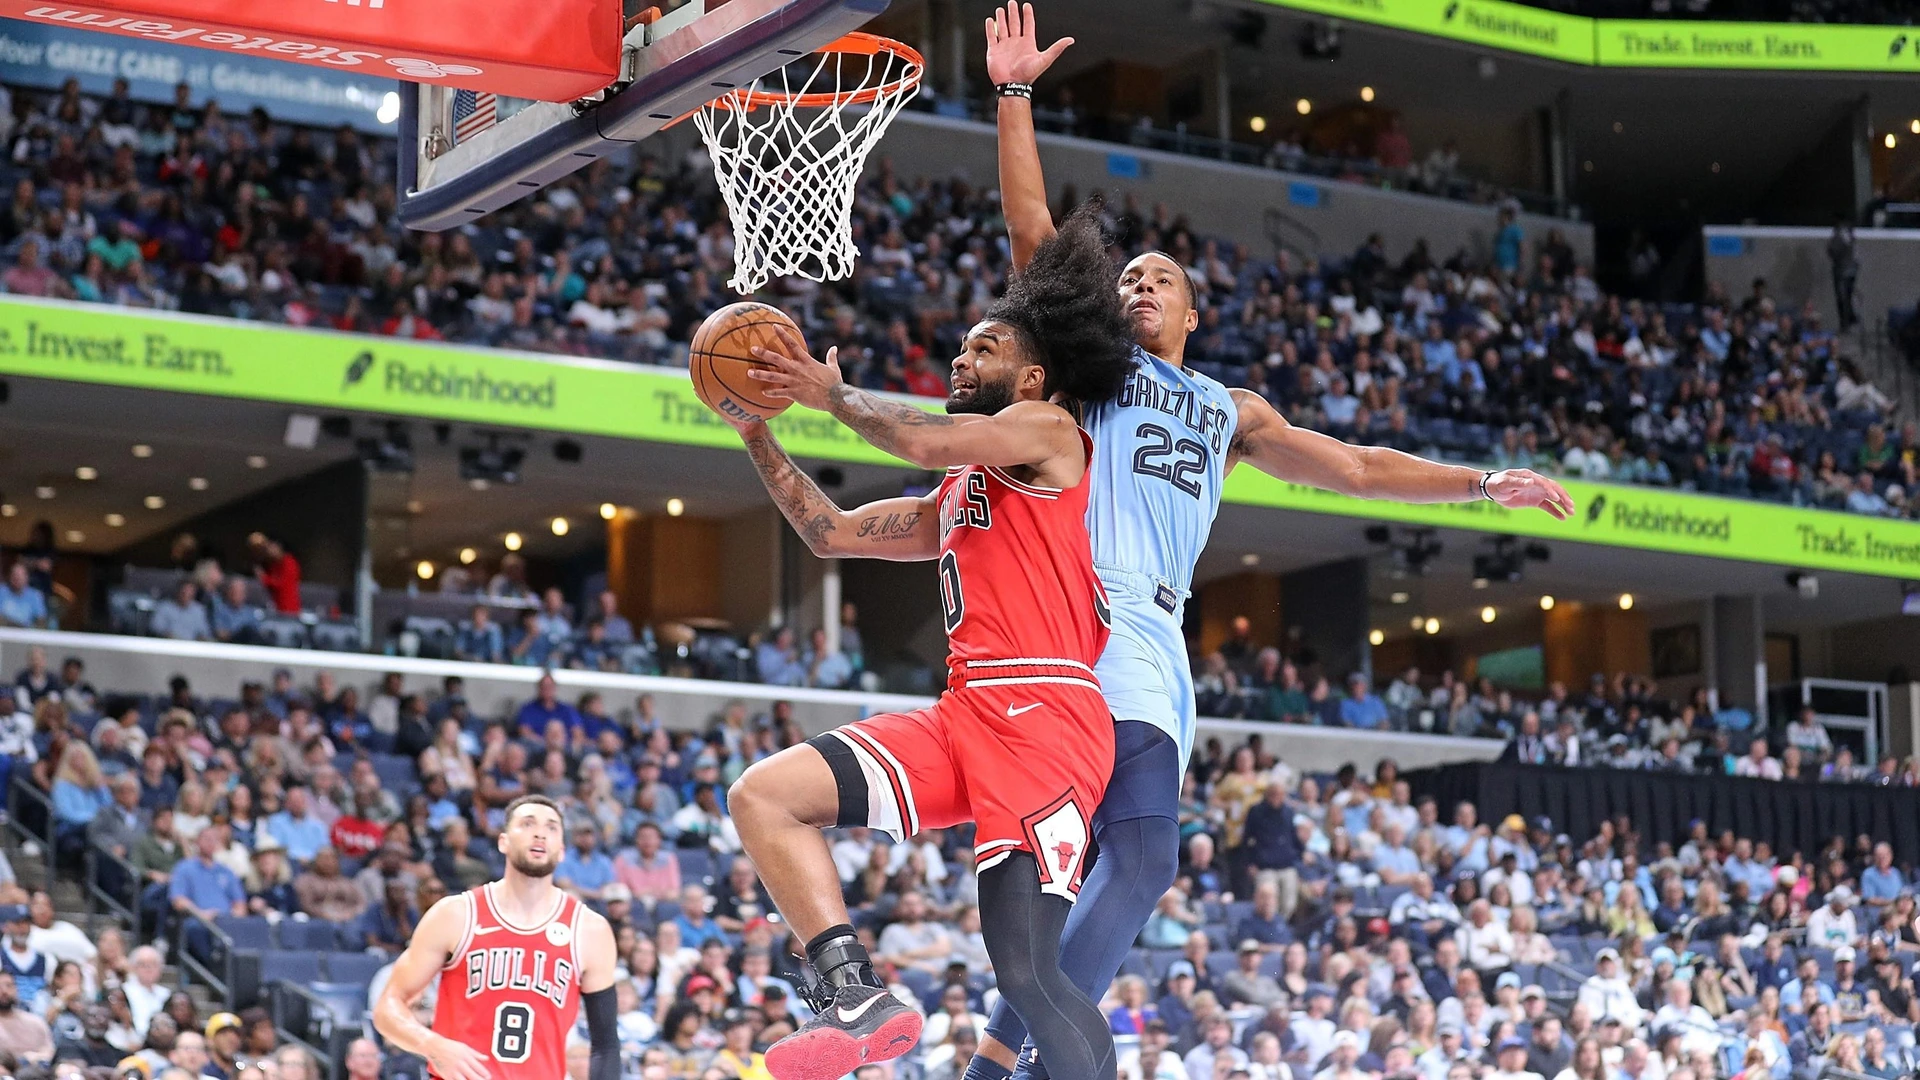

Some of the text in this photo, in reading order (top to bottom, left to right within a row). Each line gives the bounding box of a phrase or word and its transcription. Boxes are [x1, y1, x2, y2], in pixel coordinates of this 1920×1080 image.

[26, 320, 136, 366] Invest.
[144, 333, 234, 376] Earn.
[385, 359, 557, 410] Robinhood
[1132, 422, 1208, 501] 22
[940, 471, 993, 543] LLS
[1613, 501, 1730, 542] Robinhood
[939, 548, 965, 636] 0
[466, 948, 573, 1009] BULLS
[491, 1001, 536, 1064] 8
